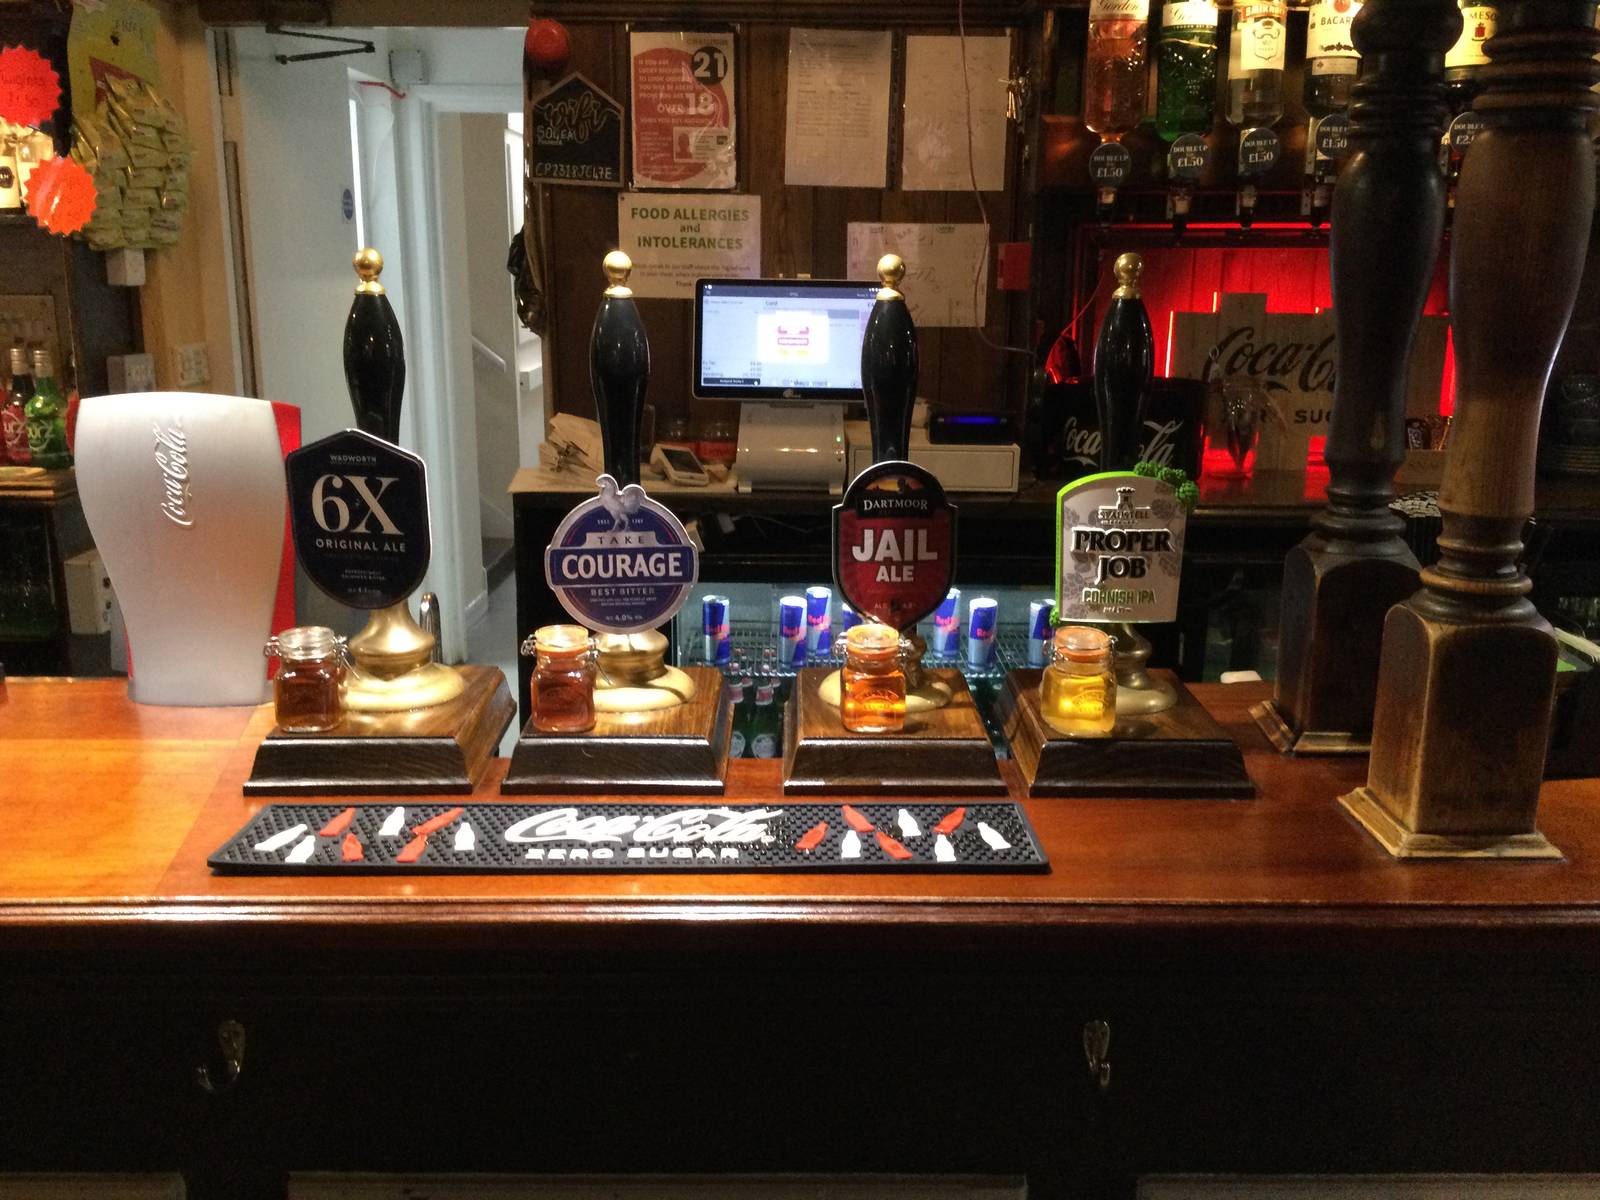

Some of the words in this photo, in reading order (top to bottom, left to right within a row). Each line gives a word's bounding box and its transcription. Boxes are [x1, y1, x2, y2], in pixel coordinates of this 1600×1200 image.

[1321, 16, 1354, 26] BACAR
[694, 51, 725, 78] 21
[685, 92, 716, 115] 18
[1322, 138, 1348, 148] £1.50
[1177, 157, 1204, 168] £1.50
[1248, 151, 1274, 163] £1.50
[1097, 167, 1123, 178] £1.50
[631, 207, 670, 220] FOOD
[673, 208, 750, 222] ALLERGIES
[680, 224, 701, 233] and
[638, 236, 743, 250] INTOLERANCES
[1202, 326, 1336, 392] Coca-Co
[329, 454, 377, 463] WADWORTH
[311, 473, 405, 537] 6X
[863, 499, 929, 511] DARTMOOR
[315, 538, 378, 551] ORIGINAL
[384, 542, 406, 553] ALE
[597, 535, 647, 545] TAKE
[851, 529, 938, 562] JAIL
[1070, 526, 1176, 553] PROPER
[561, 553, 683, 580] COURAGE
[1094, 555, 1147, 585] JOB
[876, 565, 914, 583] ALE
[590, 588, 616, 596] BEST
[619, 587, 655, 596] BITTER
[1082, 587, 1134, 604] CORNISH
[1137, 588, 1157, 604] IPA
[525, 848, 614, 861] ZERO
[627, 847, 740, 861] SUGAR
